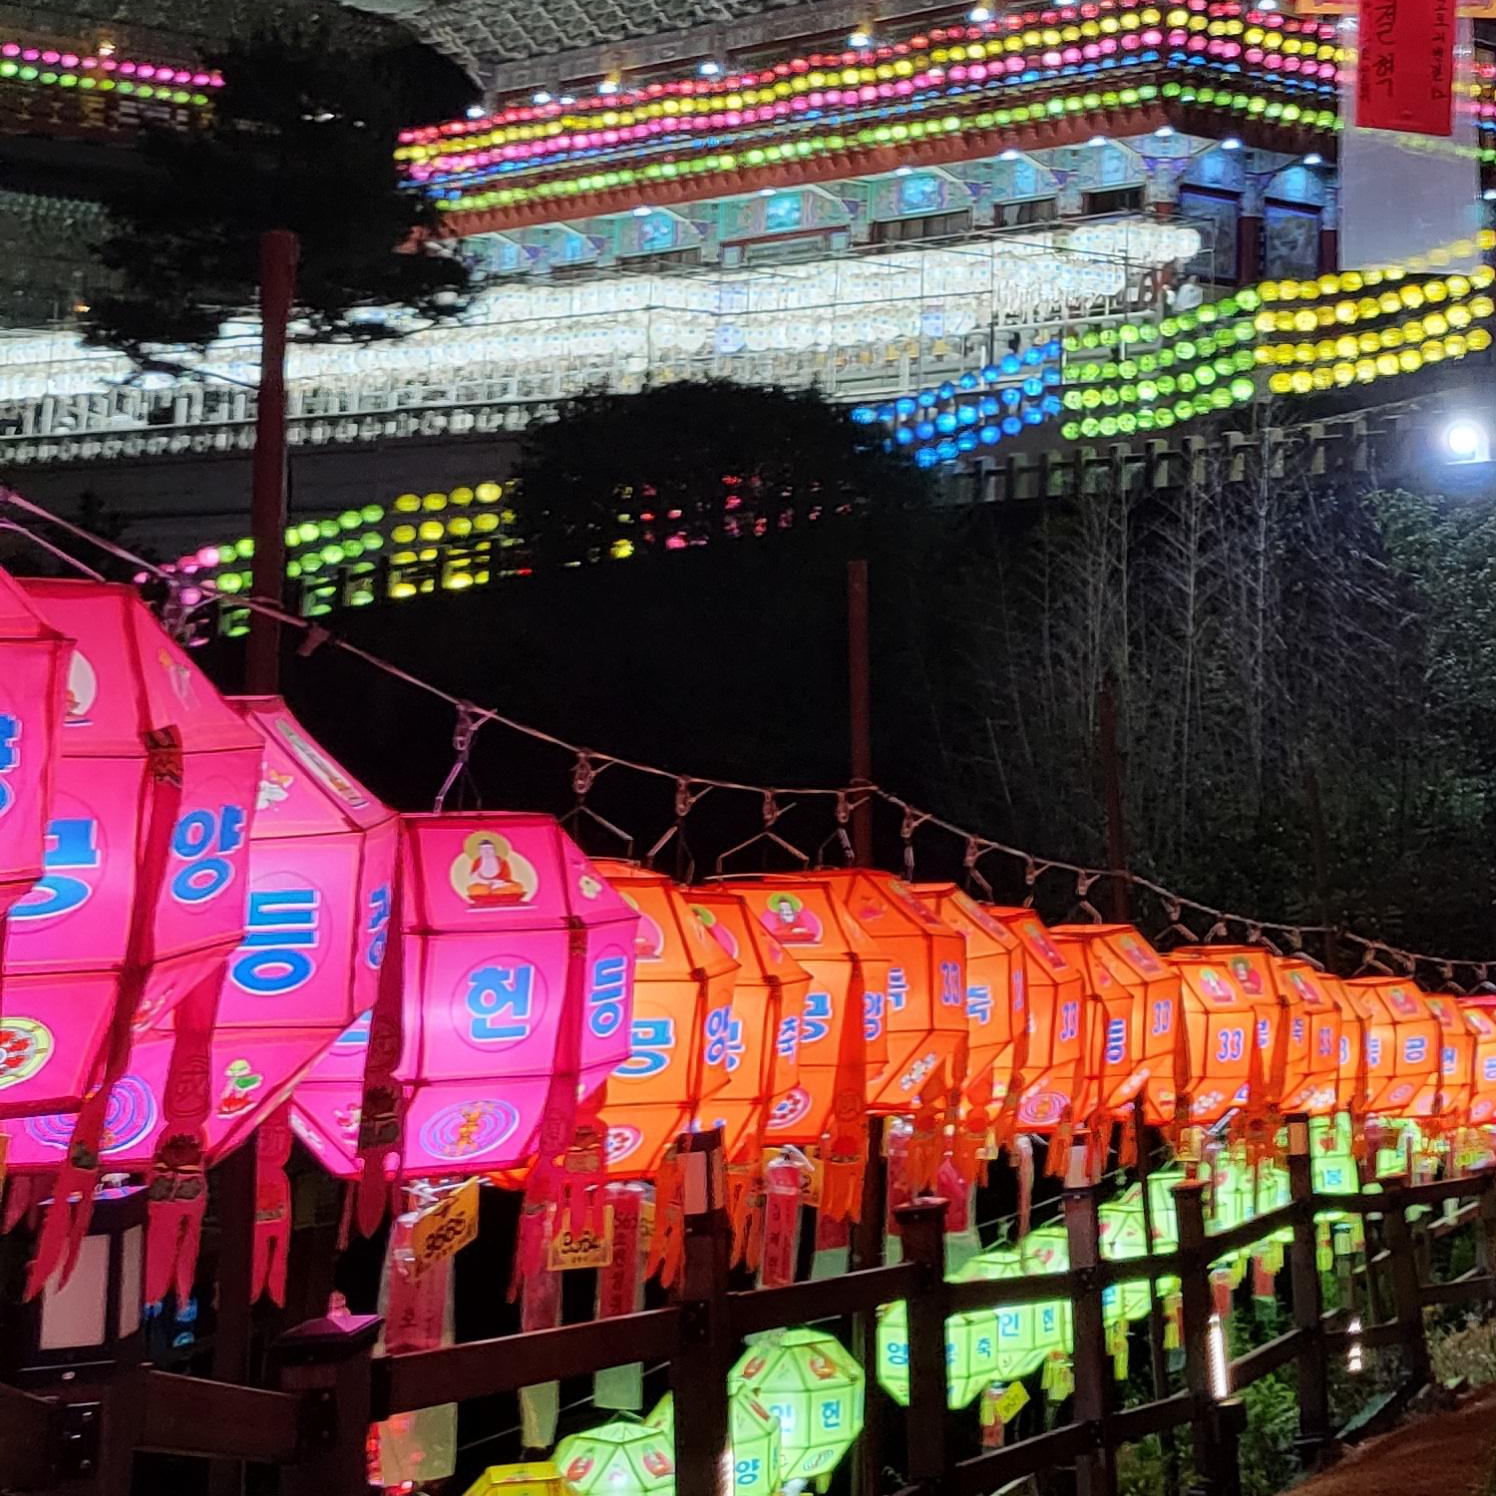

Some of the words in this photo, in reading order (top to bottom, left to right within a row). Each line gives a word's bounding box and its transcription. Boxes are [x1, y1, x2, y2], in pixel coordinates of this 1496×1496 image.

[172, 803, 246, 904] 양
[229, 886, 322, 996] 등
[589, 955, 628, 1038] 등
[1215, 1026, 1244, 1064] 33
[735, 1458, 760, 1486] 양
